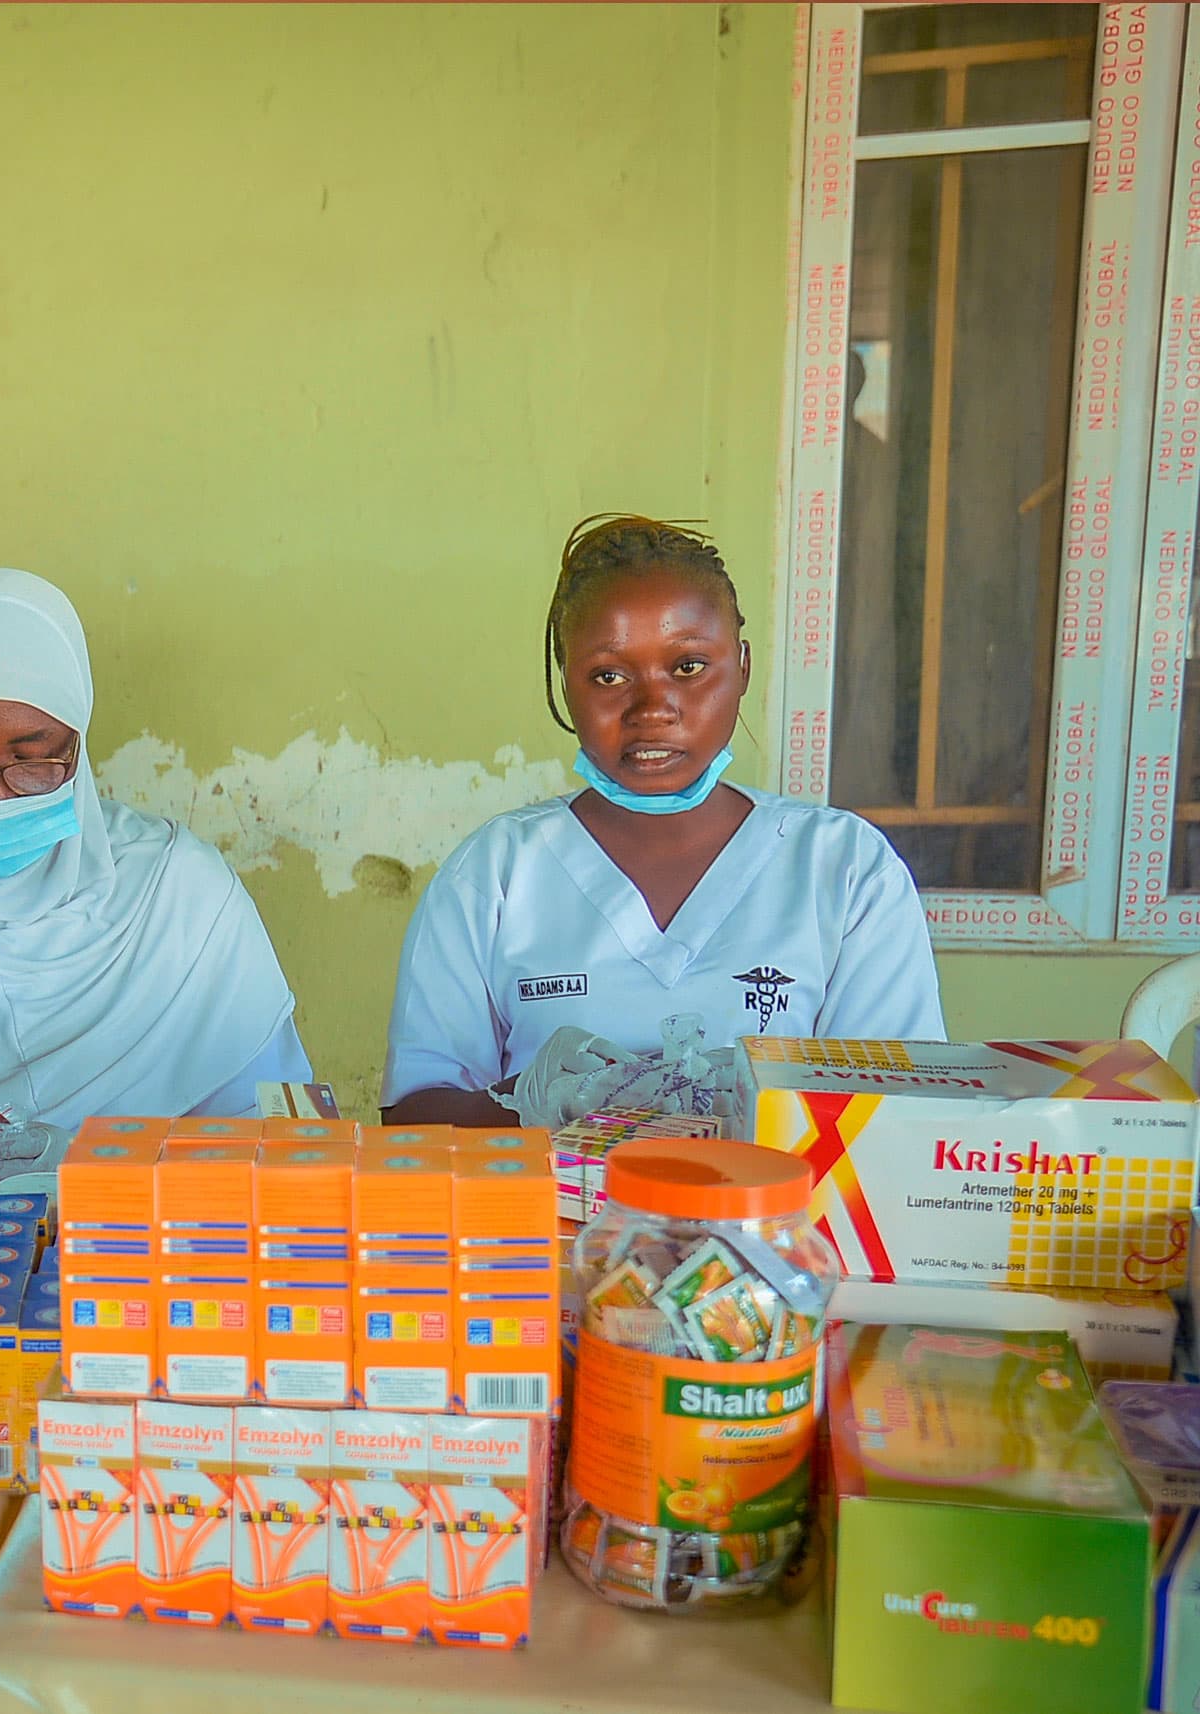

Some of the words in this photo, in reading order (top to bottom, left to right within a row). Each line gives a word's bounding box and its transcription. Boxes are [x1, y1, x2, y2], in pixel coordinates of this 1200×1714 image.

[825, 28, 847, 124] NEDUCO
[821, 133, 841, 221] GLOBAL
[1092, 97, 1114, 194] NEDUCO
[1117, 95, 1139, 192] NEDUCO
[806, 264, 823, 356] NEDUCO
[828, 263, 847, 355] NEDUCO
[1095, 240, 1117, 328] GLOBAL
[801, 364, 819, 448] GLOBAL
[824, 363, 842, 447] GLOBAL
[1089, 338, 1109, 431] NEDUCO
[1177, 400, 1199, 485] GLOBAL
[806, 489, 824, 579] NEDUCO
[1068, 476, 1088, 560] GLOBAL
[1091, 474, 1112, 560] GLOBAL
[1062, 569, 1082, 658] NEDUCO
[1085, 569, 1105, 658] NEDUCO
[1155, 530, 1176, 621] NEDUCO
[803, 588, 820, 669] GLOBAL
[1148, 630, 1168, 712] GLOBAL
[788, 710, 806, 795] NEDUCO
[809, 709, 827, 794] NEDUCO
[1065, 702, 1085, 783] GLOBAL
[1149, 755, 1170, 842] NEDUCO
[926, 910, 1017, 925] NEDUCO
[536, 980, 564, 995] ADAMS
[906, 1195, 993, 1212] Lumefantrine
[997, 1200, 1020, 1213] 120
[1024, 1203, 1044, 1216] mg
[1049, 1202, 1093, 1215] Tablets
[962, 1182, 1034, 1198] Artemether
[1038, 1186, 1054, 1198] 20
[1059, 1189, 1078, 1201] mg
[912, 1258, 947, 1267] NAFDAC
[42, 1419, 125, 1440] Emzolyn
[140, 1421, 224, 1442] Emzolyn
[238, 1427, 324, 1449] Emzolyn
[334, 1430, 422, 1452] Emzolyn
[431, 1434, 520, 1456] Emzolyn
[719, 1421, 785, 1440] Natural
[883, 1590, 976, 1621] UniCure
[937, 1617, 1030, 1641] IBUTEN
[1033, 1614, 1099, 1646] 400
